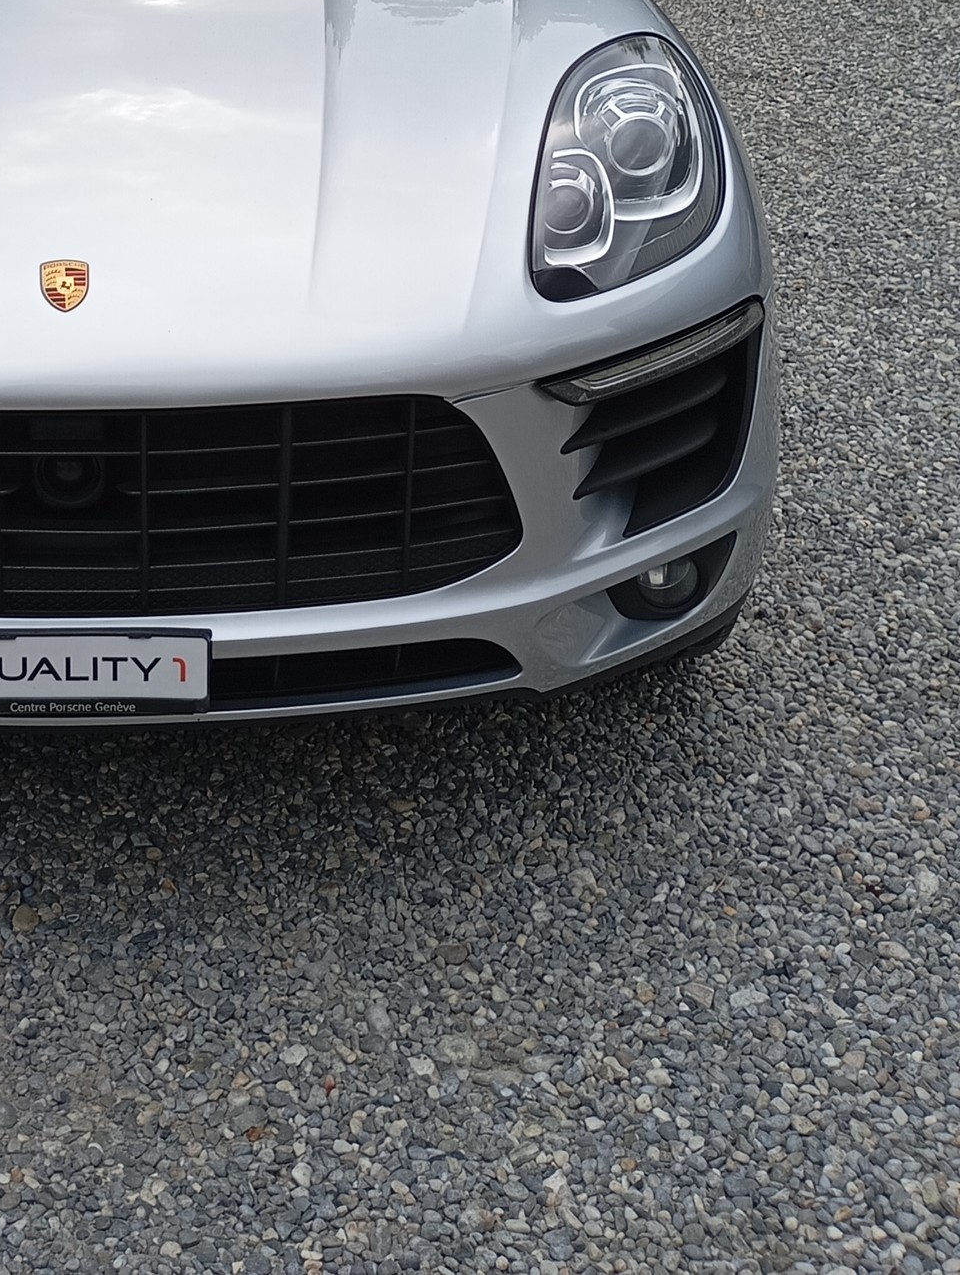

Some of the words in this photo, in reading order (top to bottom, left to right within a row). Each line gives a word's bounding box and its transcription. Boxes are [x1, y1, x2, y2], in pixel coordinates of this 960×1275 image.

[10, 701, 47, 713] Centre
[49, 701, 92, 713] Porsche
[94, 701, 137, 713] Genève
